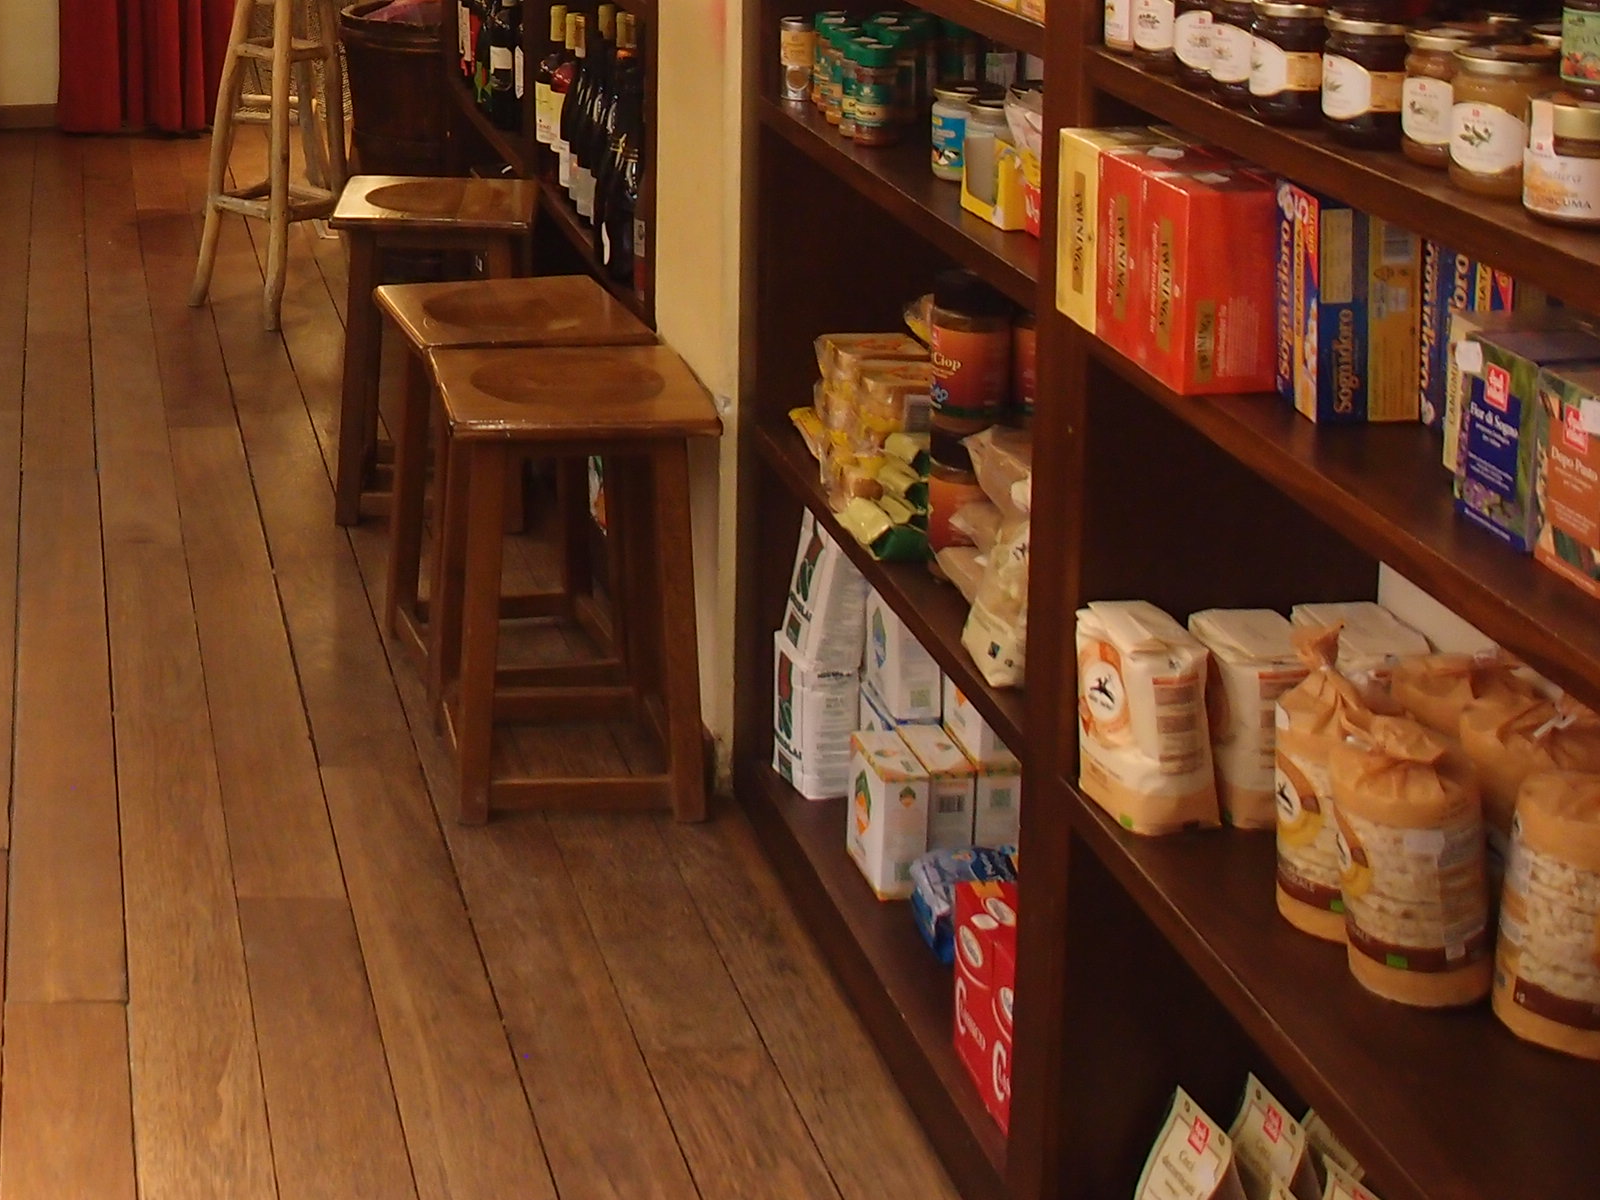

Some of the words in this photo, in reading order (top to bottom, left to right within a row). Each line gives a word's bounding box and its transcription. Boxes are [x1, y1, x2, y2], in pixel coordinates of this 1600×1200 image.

[1072, 192, 1085, 273] TWININGS
[1115, 216, 1128, 298] TWININGS
[1158, 241, 1170, 329] TWININGS
